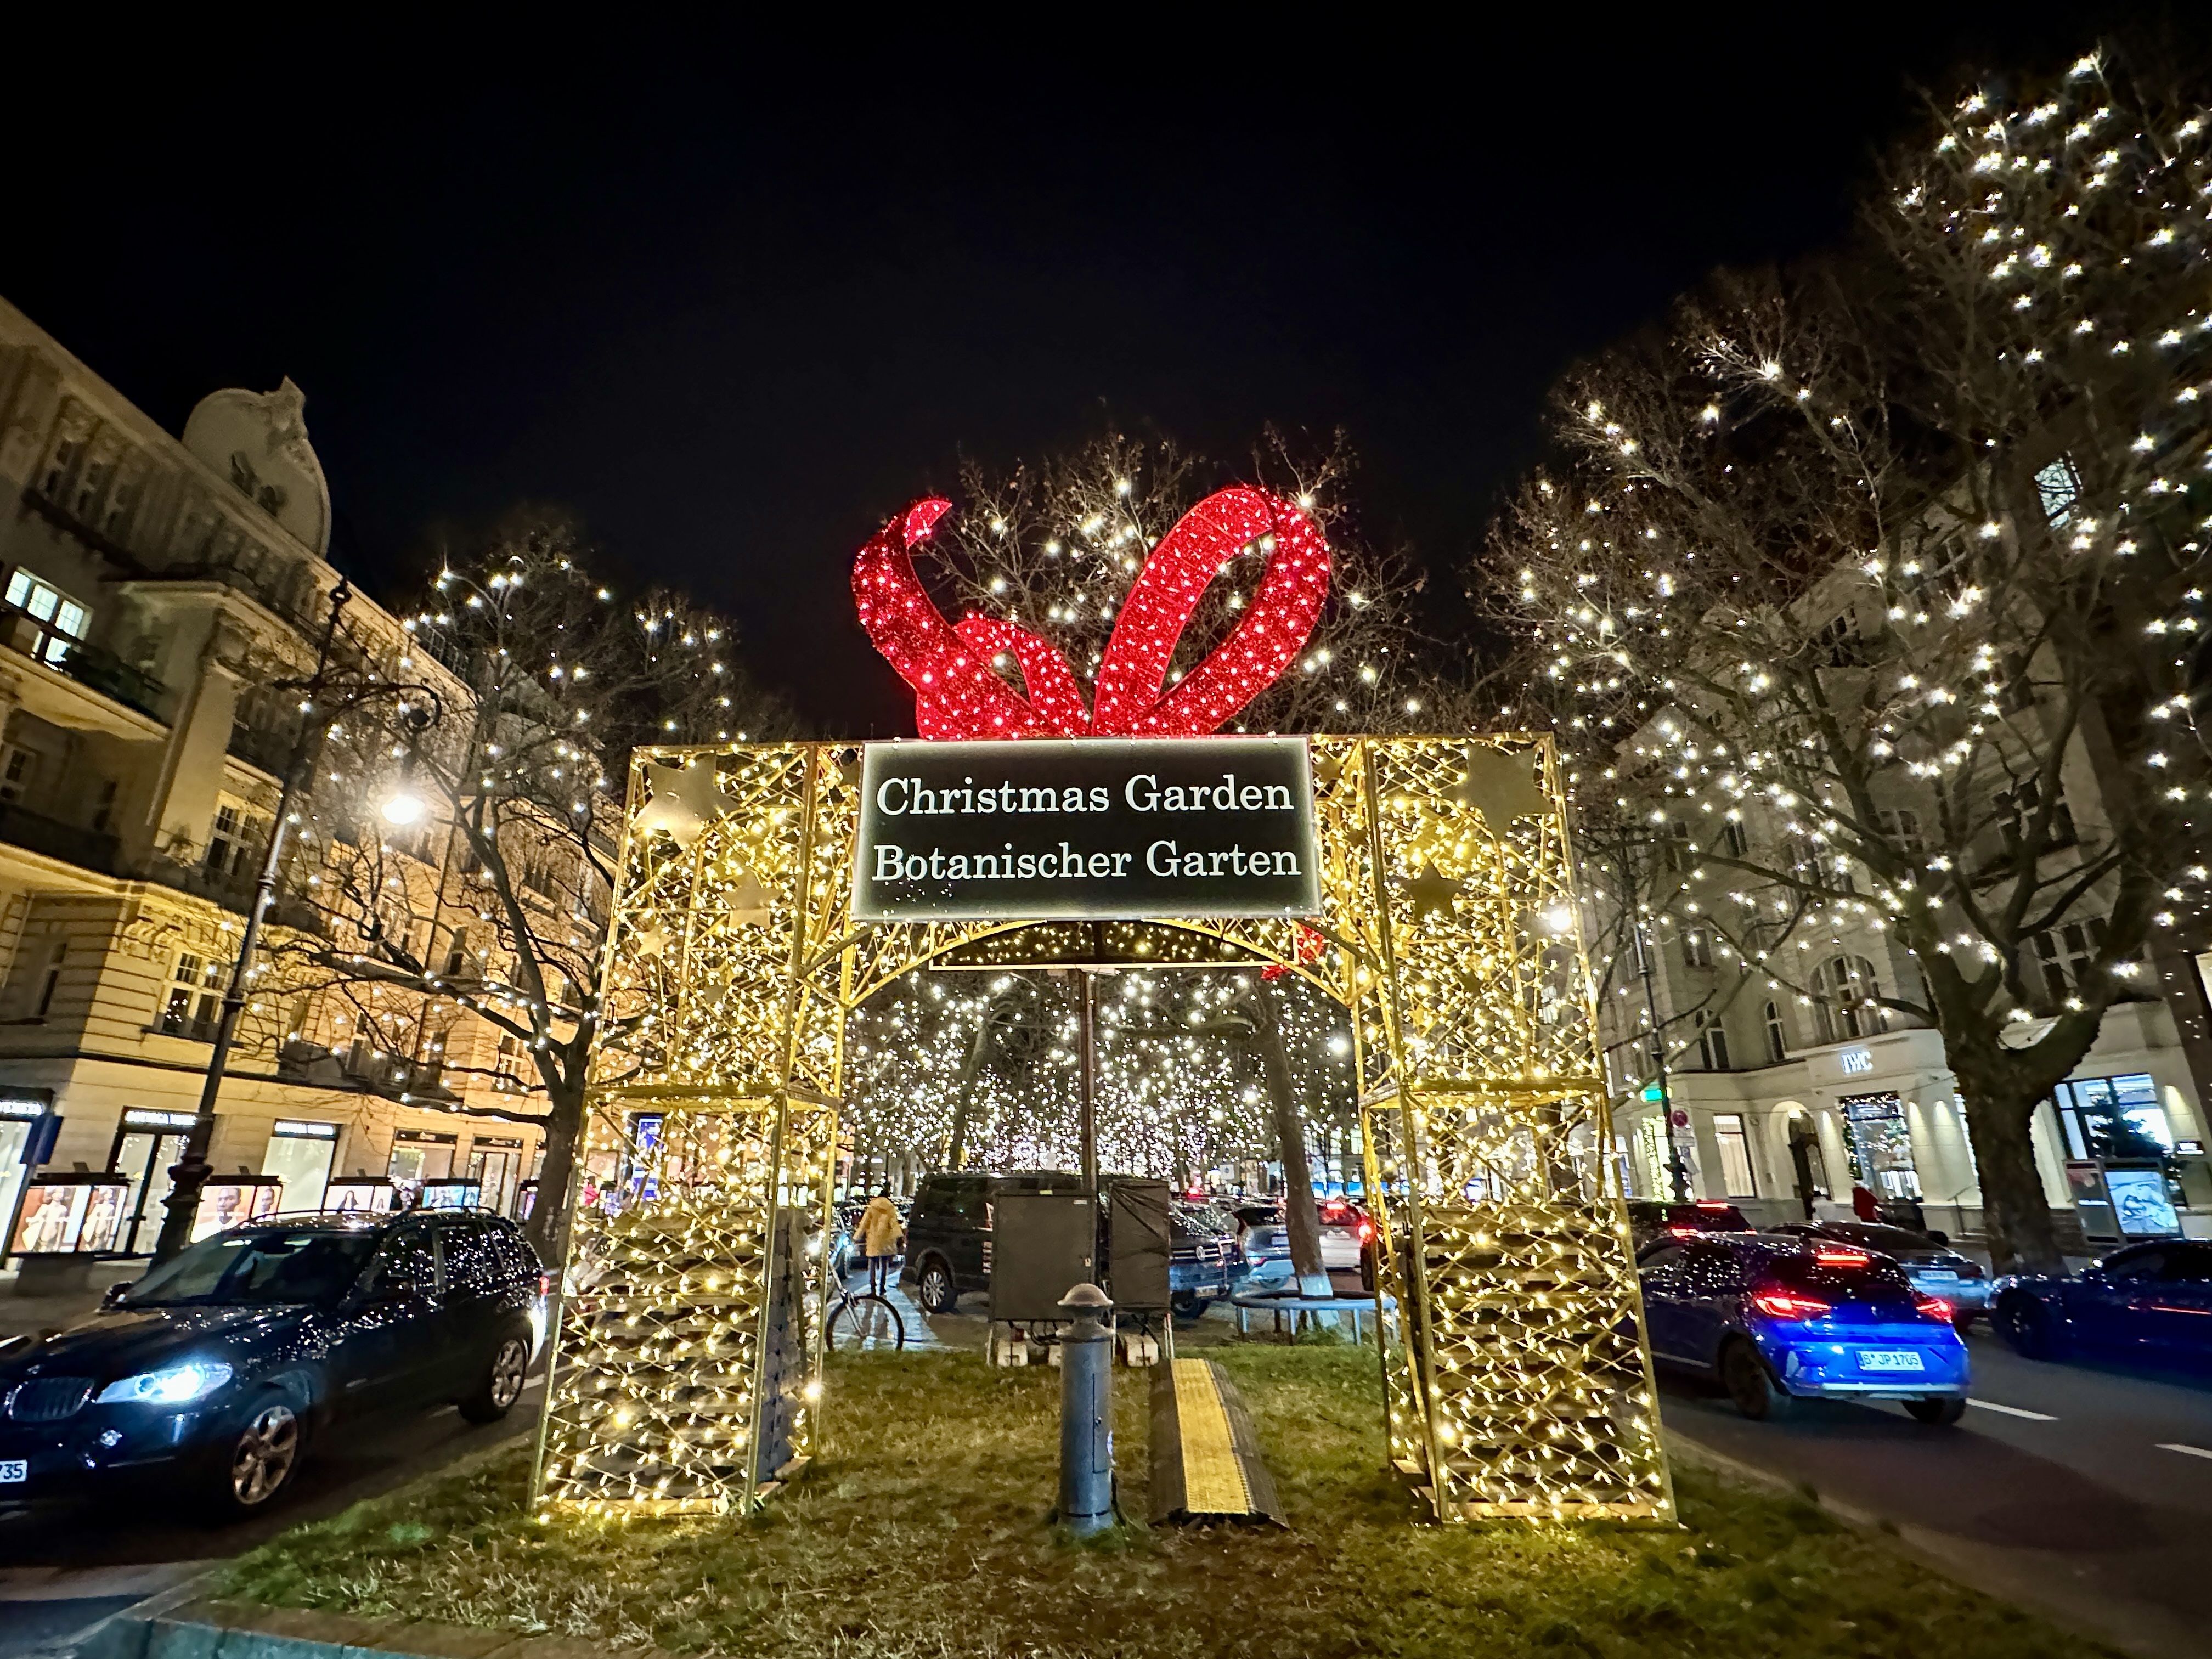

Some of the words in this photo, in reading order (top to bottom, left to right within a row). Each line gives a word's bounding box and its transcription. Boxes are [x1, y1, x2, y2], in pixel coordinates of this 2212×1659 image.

[877, 777, 1109, 816] Christmas
[1125, 774, 1294, 812] Garden
[872, 842, 1132, 881] Botanischer
[1147, 840, 1301, 877] Garten
[1841, 1051, 1873, 1074] IWC
